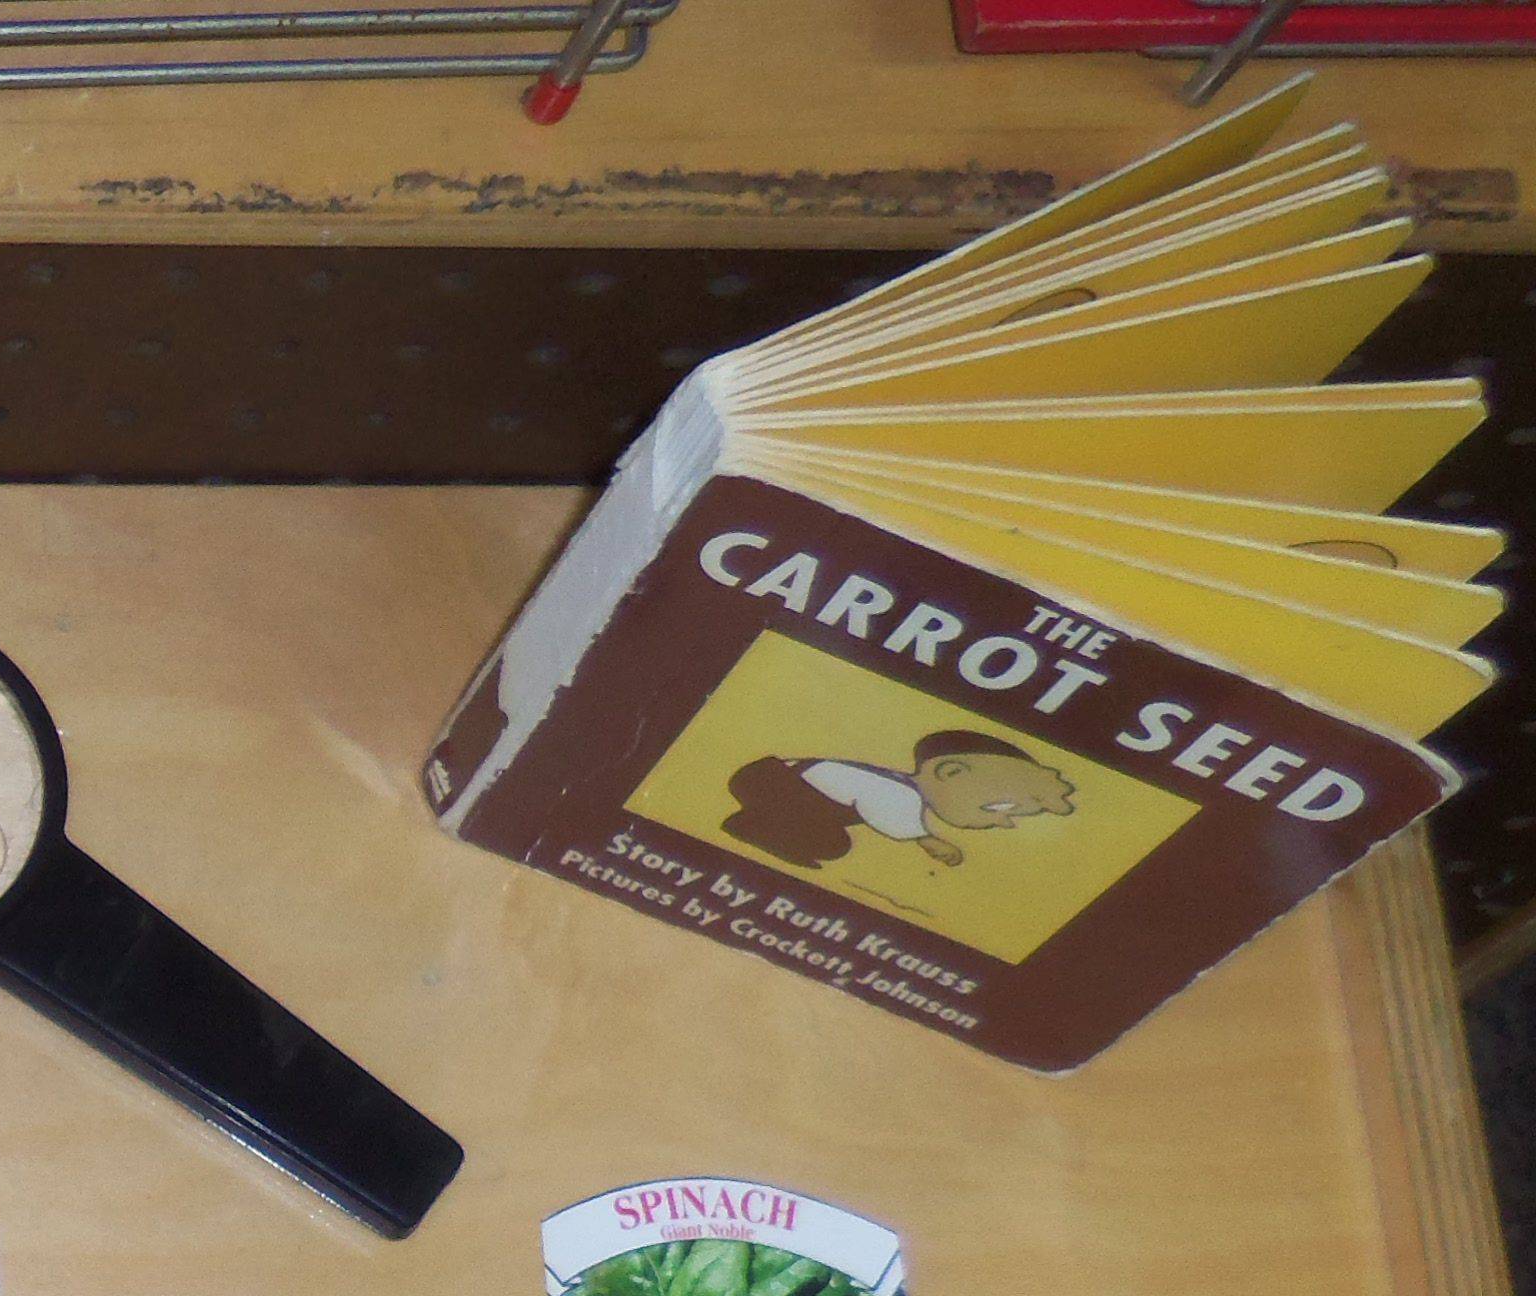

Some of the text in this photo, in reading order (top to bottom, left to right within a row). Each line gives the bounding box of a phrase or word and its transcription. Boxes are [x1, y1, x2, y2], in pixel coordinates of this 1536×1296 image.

[698, 531, 1366, 825] CARROT SEED
[1024, 605, 1119, 660] THE
[560, 848, 979, 1030] Pictures by Crockett Johnson
[605, 832, 979, 995] Story by Ruth Krauss
[612, 1185, 798, 1232] SPINACH
[660, 1222, 756, 1240] Giant Noble
